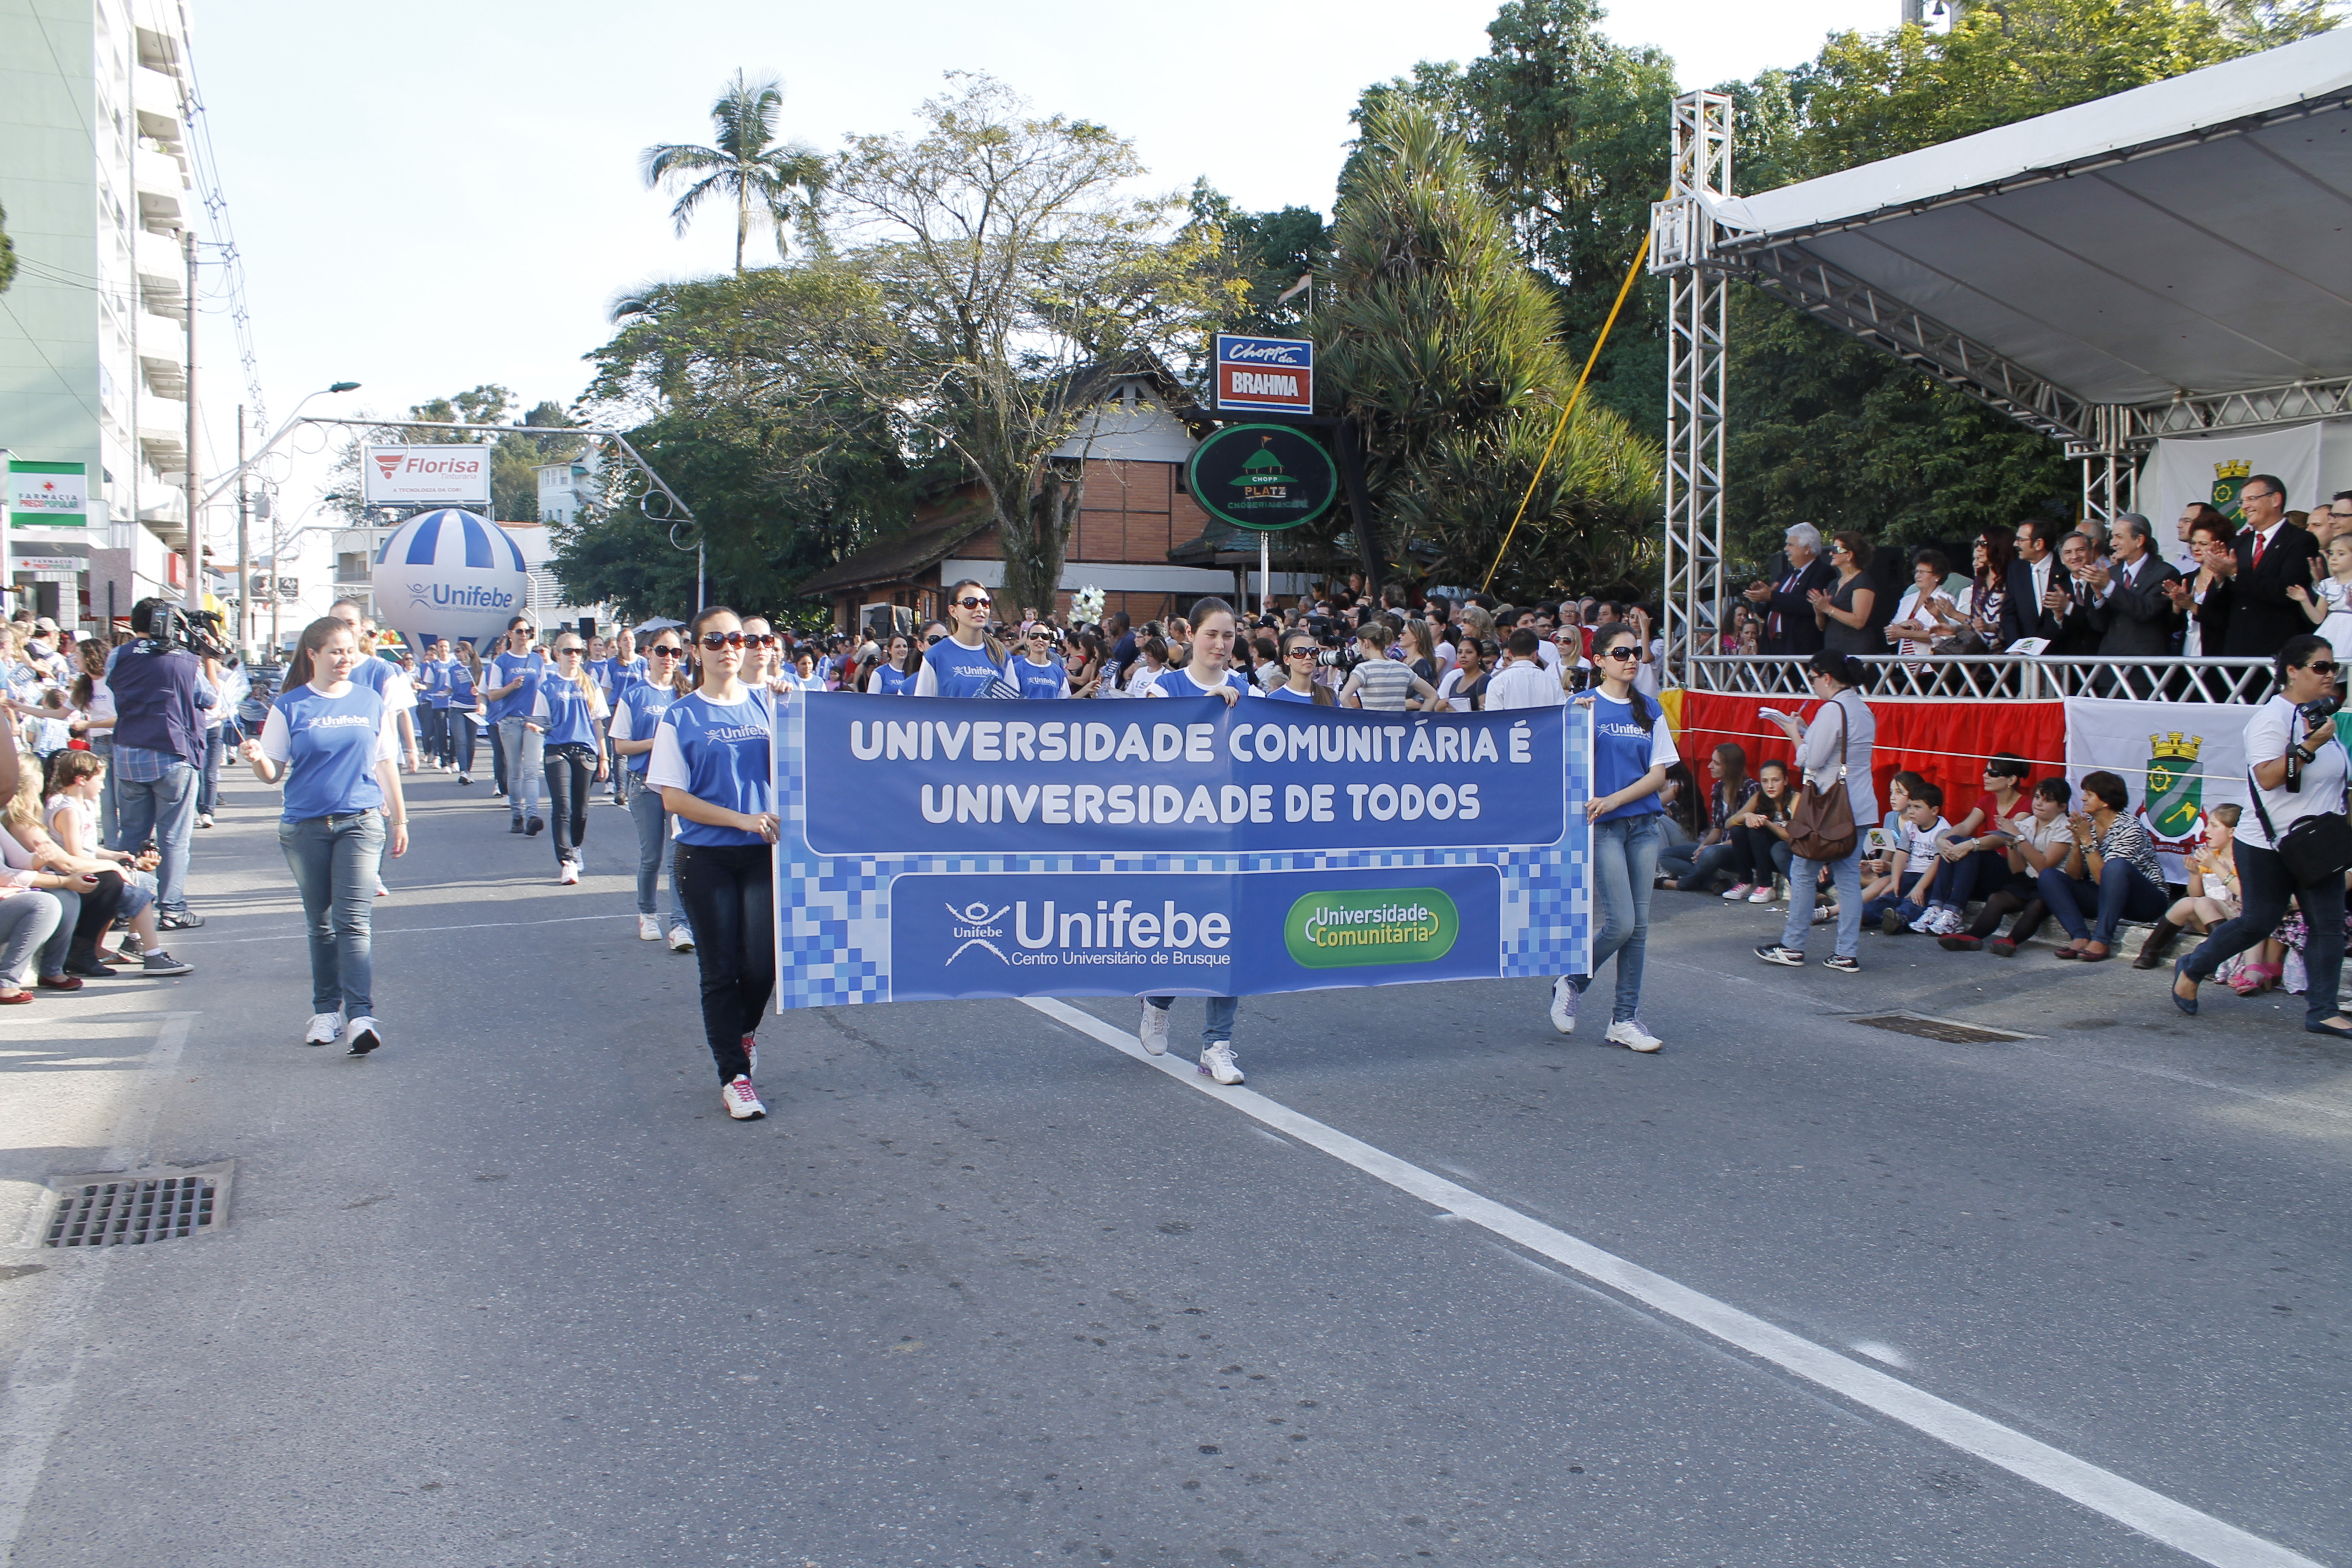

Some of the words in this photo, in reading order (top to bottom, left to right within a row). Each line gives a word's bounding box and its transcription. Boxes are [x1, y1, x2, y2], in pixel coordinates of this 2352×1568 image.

[1229, 343, 1303, 361] Chopp
[1278, 353, 1297, 363] da
[1232, 371, 1299, 397] BRAHMA
[406, 458, 479, 473] Florisa
[1244, 486, 1286, 496] PLATZ
[433, 583, 513, 608] Unifebe
[1035, 677, 1057, 686] Unifebe
[322, 715, 369, 726] Unifebe
[851, 720, 1215, 763] UNIVERSIDADE
[1228, 718, 1499, 763] COMUNITÁRIA
[1509, 719, 1532, 763] É
[921, 783, 1273, 824] UNIVERSIDADE
[1285, 784, 1335, 823] DE
[1347, 783, 1480, 821] TODOS
[2155, 844, 2186, 853] BRUSQUE
[1015, 900, 1231, 949] Unifebe
[1316, 903, 1428, 926] Universidade
[954, 927, 1003, 938] Unifebe
[1316, 922, 1429, 947] Comunitária
[1011, 951, 1058, 965] Centro
[1063, 951, 1147, 965] Universitário
[1151, 951, 1168, 965] de
[1173, 951, 1231, 968] Brusque
